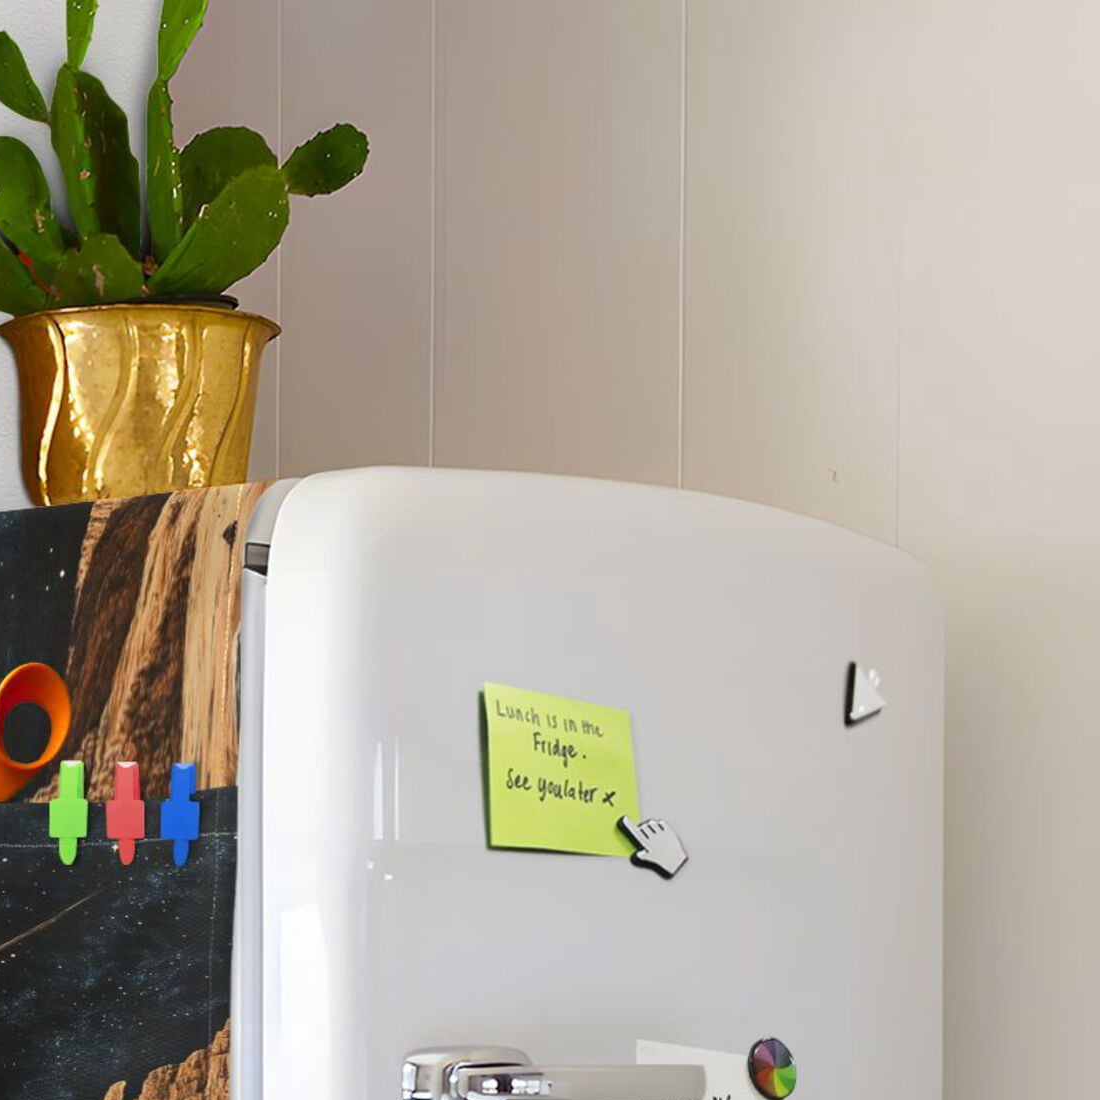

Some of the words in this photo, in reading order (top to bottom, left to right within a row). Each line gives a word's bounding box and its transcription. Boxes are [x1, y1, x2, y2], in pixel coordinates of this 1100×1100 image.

[495, 699, 541, 727] Lunch
[564, 718, 578, 733] in
[582, 719, 604, 738] the
[506, 768, 532, 790] See
